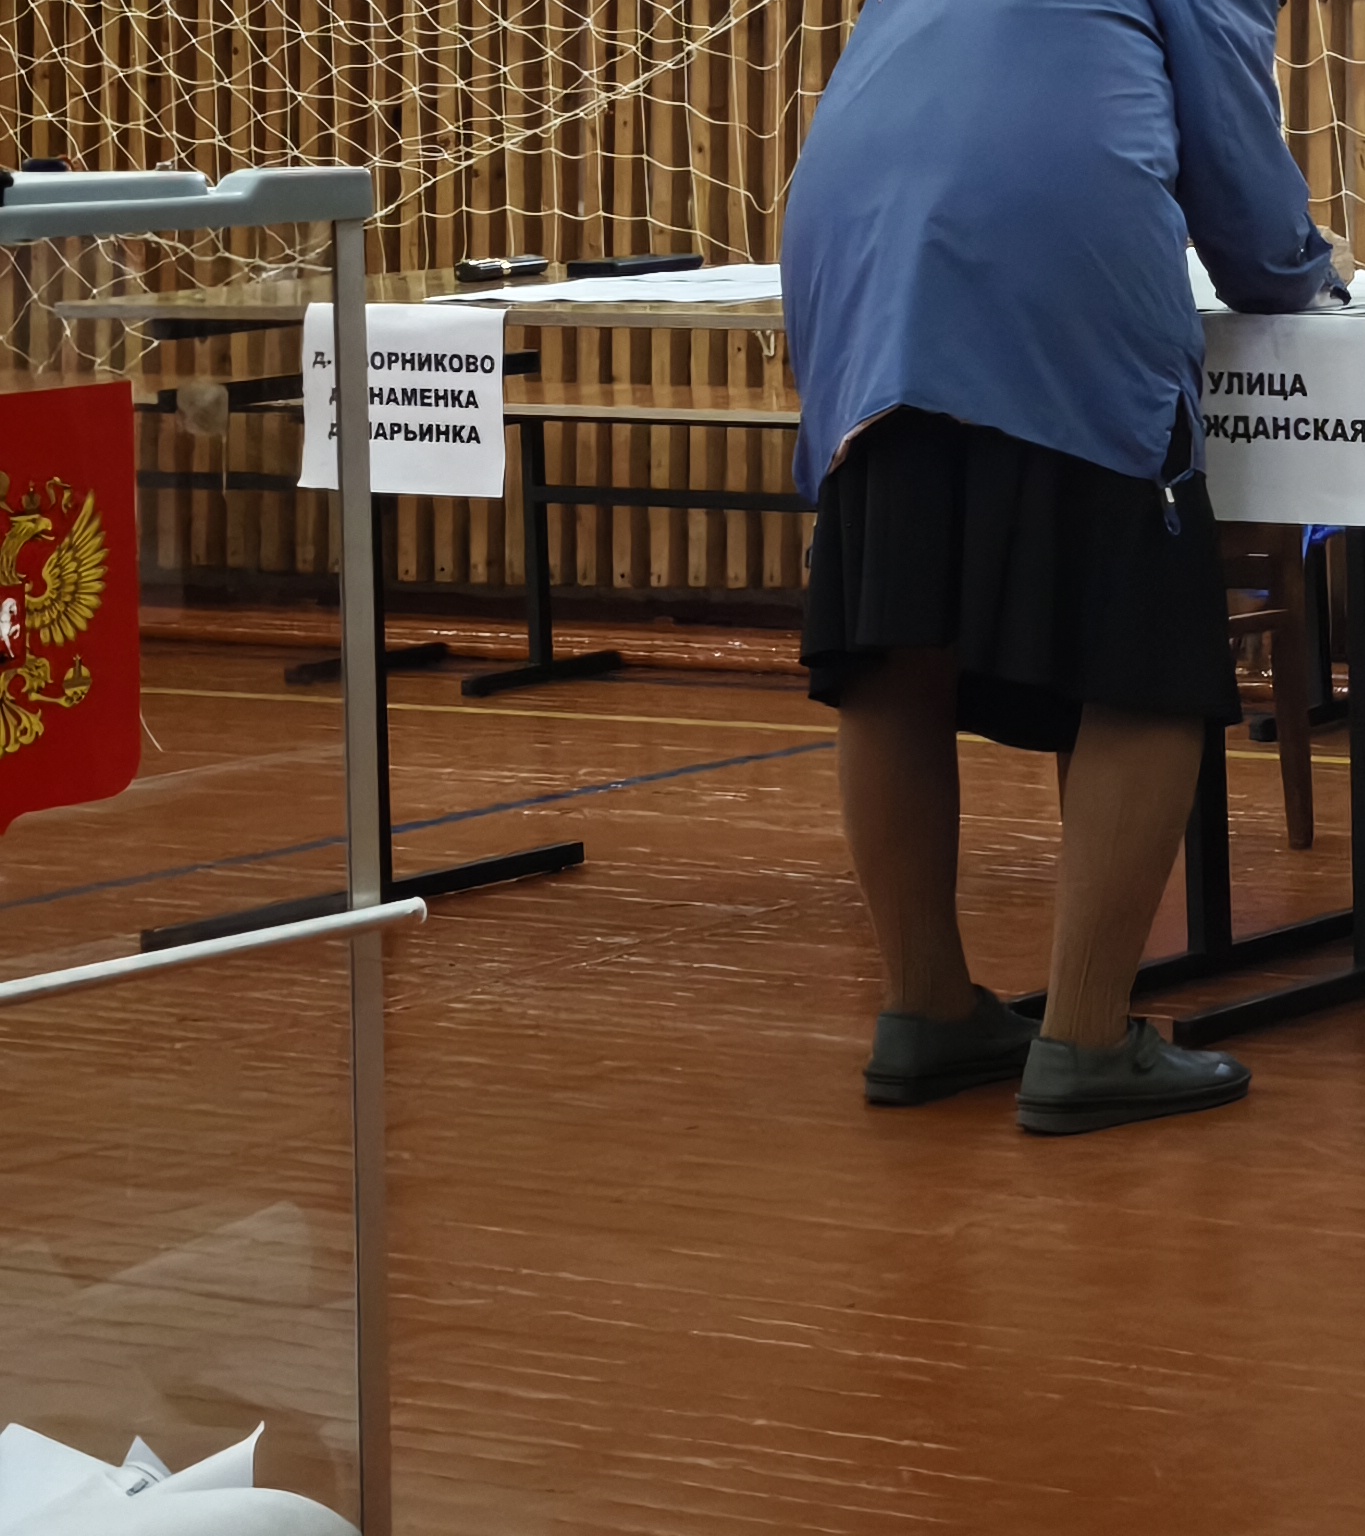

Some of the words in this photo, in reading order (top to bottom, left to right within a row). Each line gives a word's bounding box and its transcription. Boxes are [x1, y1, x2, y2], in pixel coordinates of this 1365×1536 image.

[312, 351, 332, 369] д.
[370, 351, 495, 374] ОРНИКОВО
[369, 386, 479, 409] НАМЕНКА
[1207, 371, 1308, 401] УЛИЦА
[369, 421, 481, 445] АРЬИНКА
